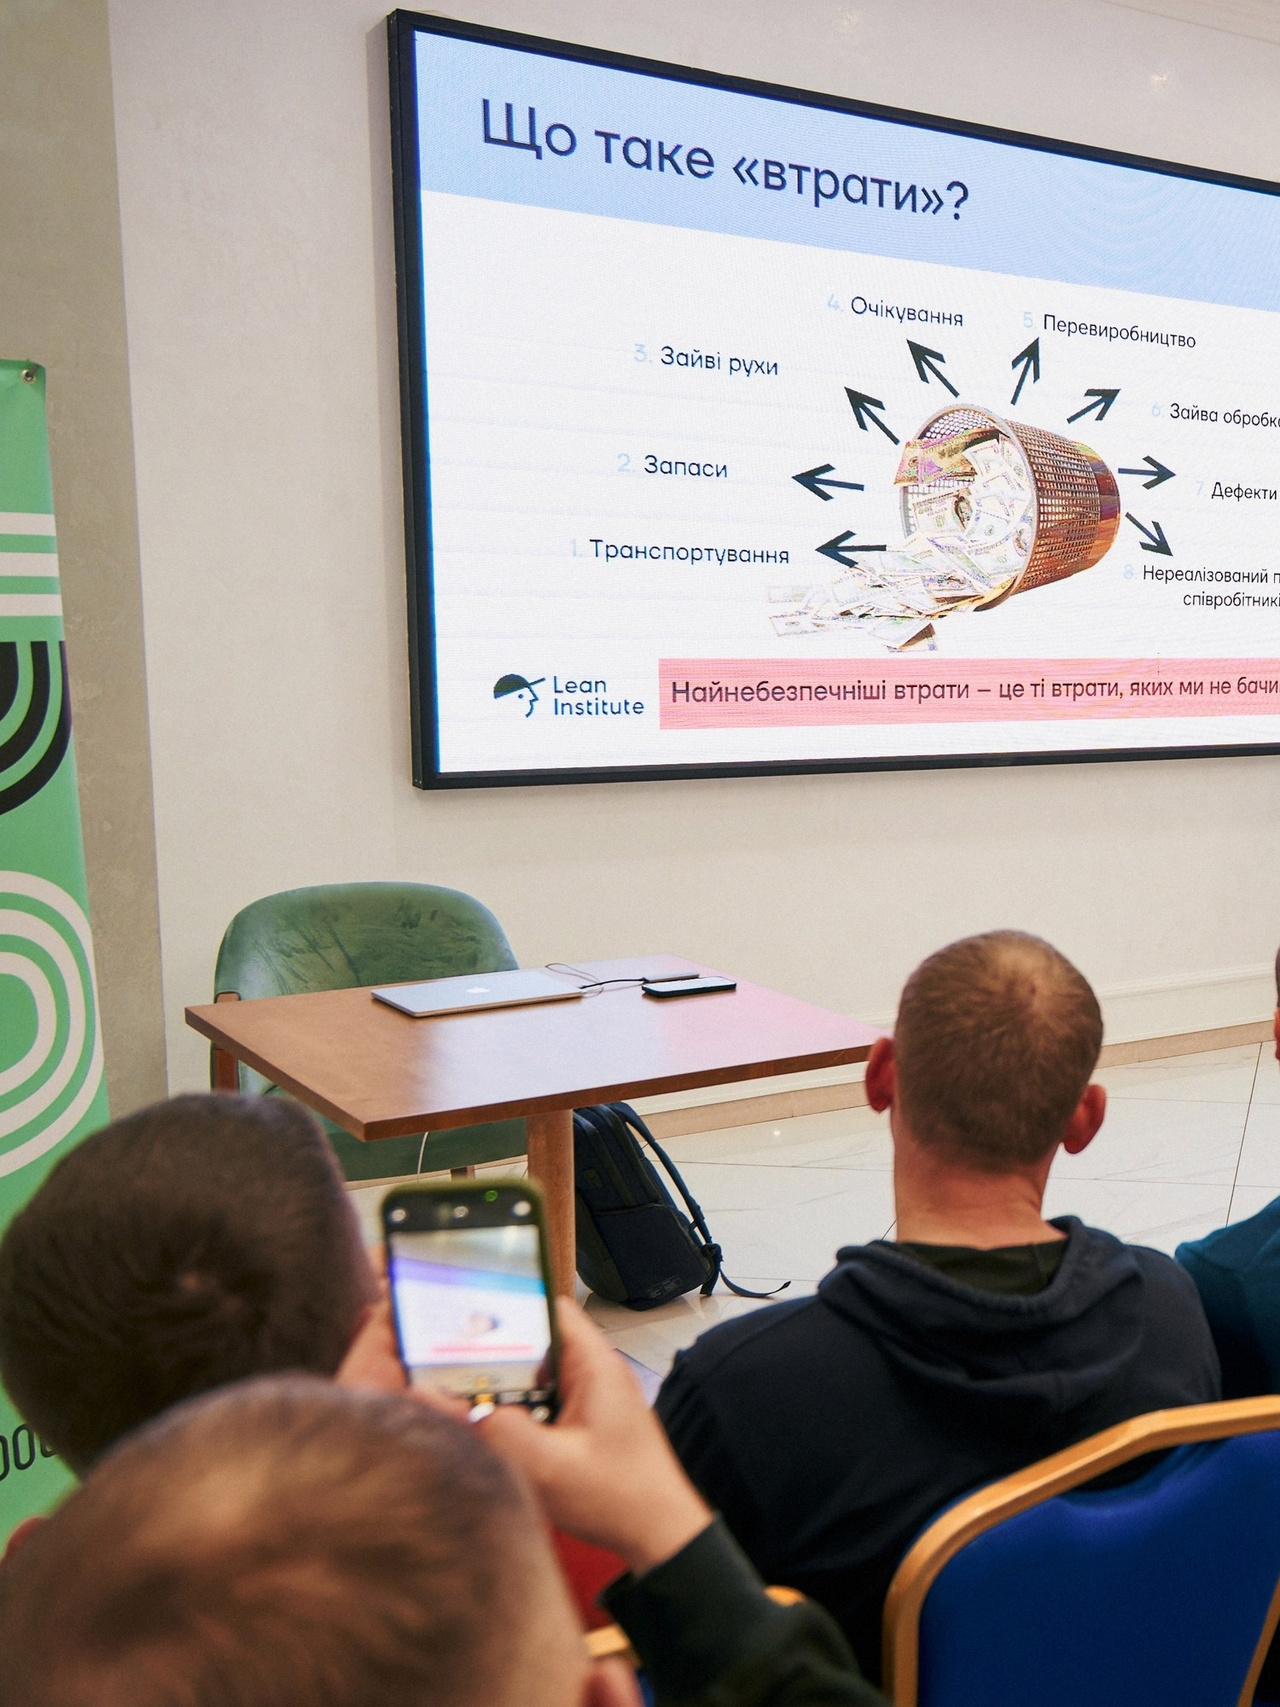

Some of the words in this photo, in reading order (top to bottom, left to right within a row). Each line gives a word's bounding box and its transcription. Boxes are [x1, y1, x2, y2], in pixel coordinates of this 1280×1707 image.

[482, 98, 578, 161] Що
[594, 130, 715, 180] таке
[732, 156, 969, 221] «втрати»?
[850, 295, 964, 327] Очікування
[1043, 313, 1197, 349] Перевиробництво
[660, 345, 721, 370] Зайві
[729, 357, 778, 378] рухи
[1169, 402, 1219, 423] Зайва
[644, 454, 728, 478] Запаси
[1211, 481, 1278, 502] Дефекти
[589, 538, 790, 566] Транспортування
[1143, 564, 1269, 585] Нереалізований
[553, 675, 607, 694] Lean
[672, 679, 886, 703] Найнебезпечніші
[894, 683, 970, 704] втрати
[999, 683, 1025, 701] це
[1029, 678, 1045, 698] ті
[1051, 682, 1123, 702] втрати,
[1130, 681, 1174, 696] яких
[1179, 681, 1204, 695] ми
[1209, 680, 1232, 695] не
[554, 697, 645, 716] Institute
